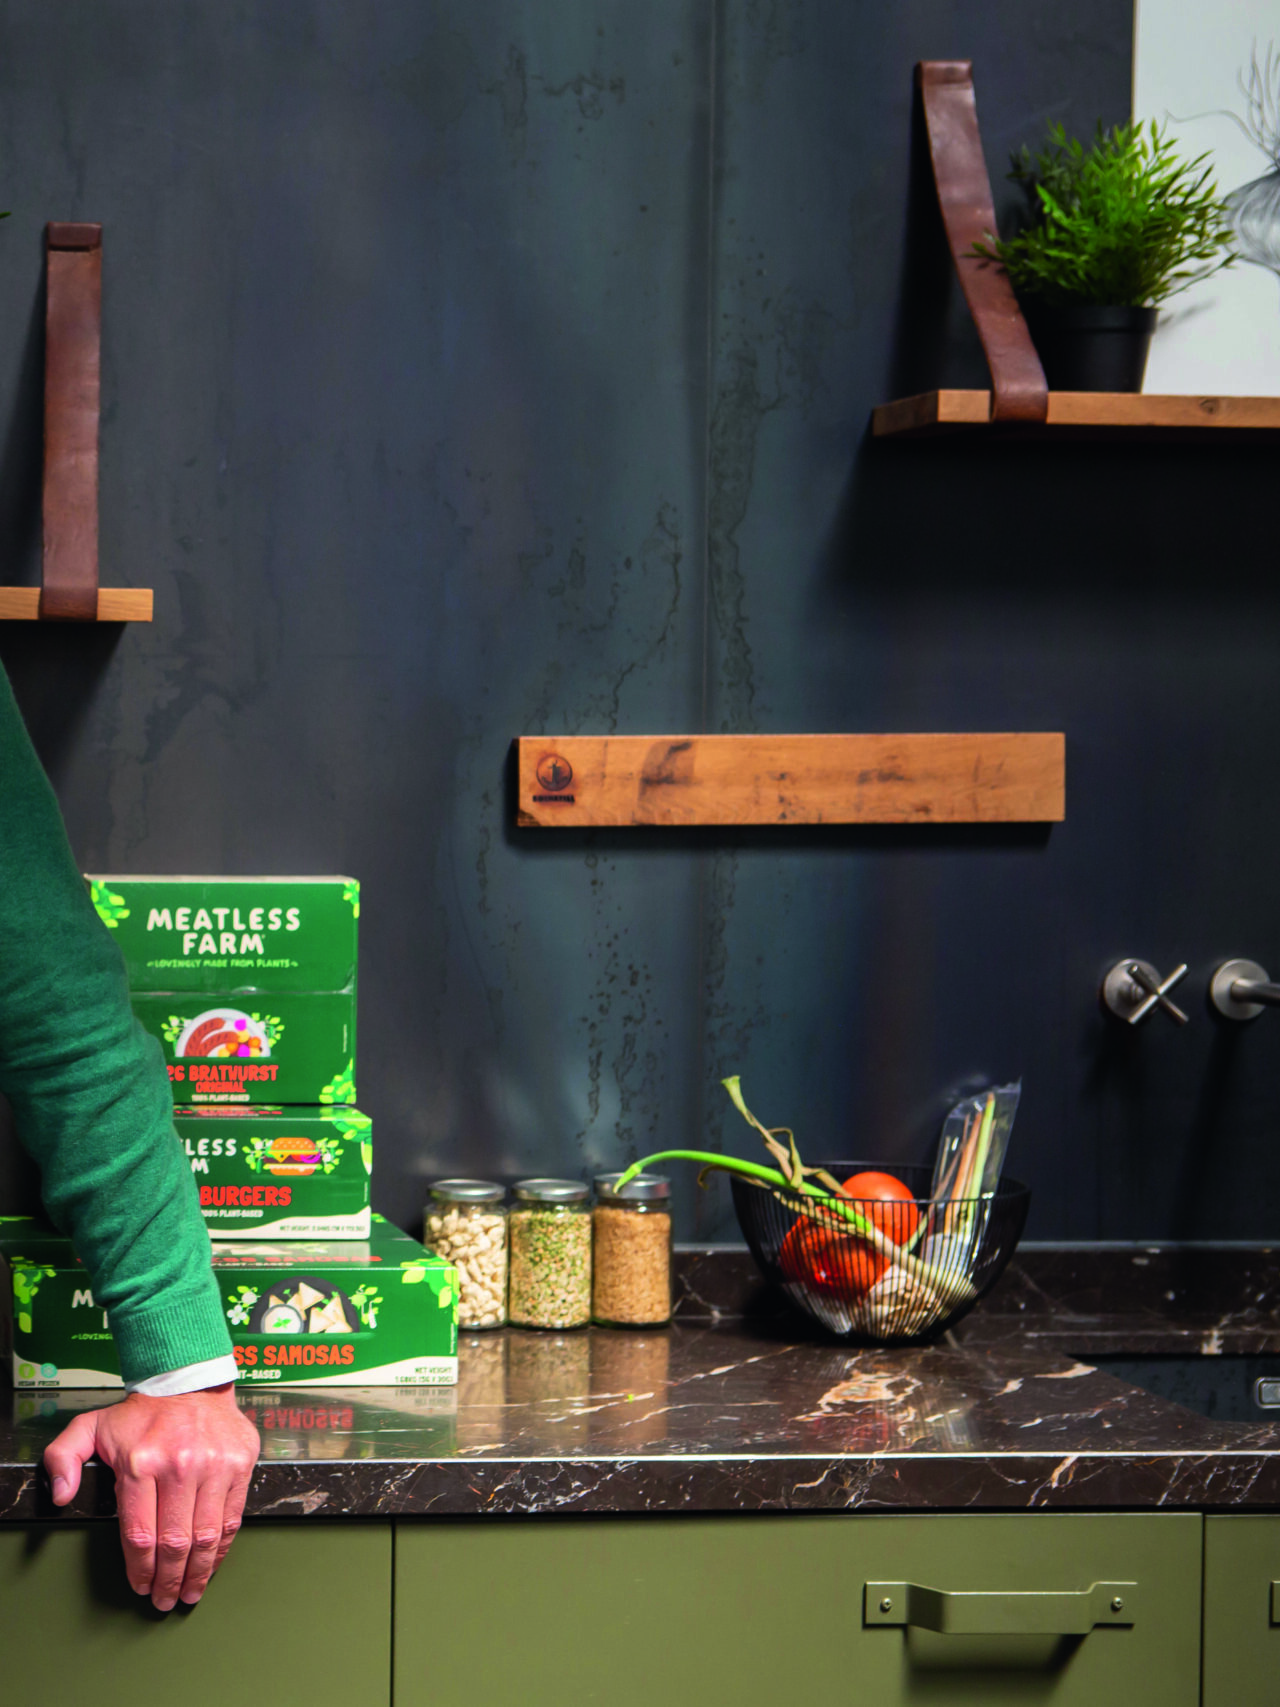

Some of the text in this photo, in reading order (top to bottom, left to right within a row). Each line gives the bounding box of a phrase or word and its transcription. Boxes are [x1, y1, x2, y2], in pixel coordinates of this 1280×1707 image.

[147, 908, 300, 931] MEATLESS
[182, 932, 266, 956] FARM
[154, 958, 291, 969] LOVINGLY MADE FROM PLANTS
[189, 1065, 279, 1081] BRATWURST
[195, 1081, 247, 1093] ORIGINAL
[180, 1138, 238, 1157] LESS
[200, 1186, 292, 1206] BURGERS
[219, 1209, 264, 1218] PLANT-BASED
[263, 1344, 355, 1366] SAMOSAS
